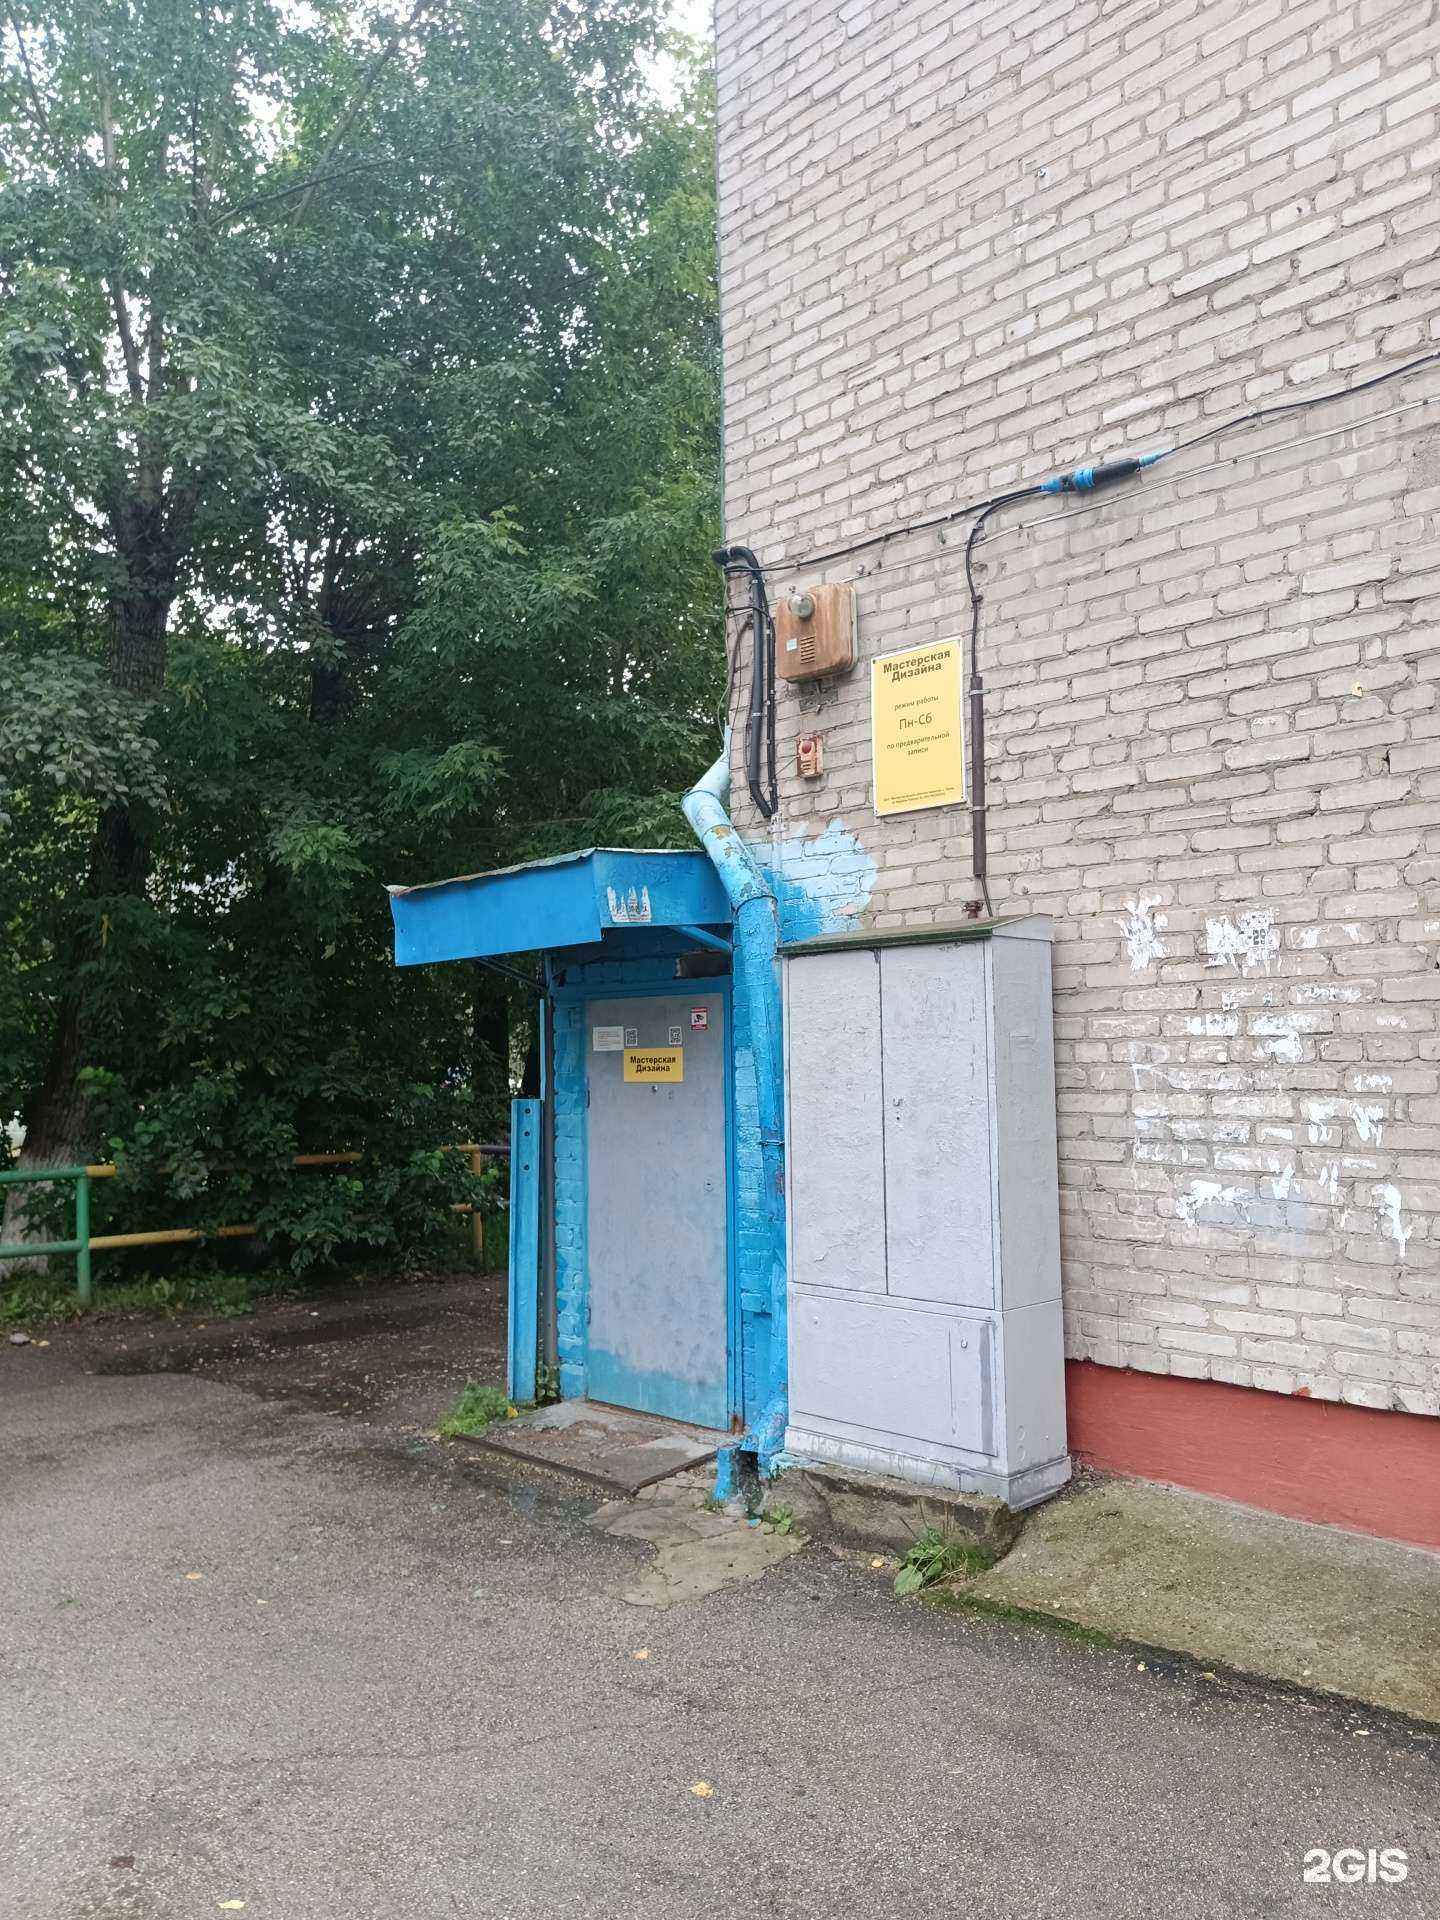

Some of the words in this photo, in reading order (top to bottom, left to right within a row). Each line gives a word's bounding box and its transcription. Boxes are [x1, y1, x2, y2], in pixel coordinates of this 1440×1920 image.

[883, 650, 951, 674] Мастерская
[891, 662, 943, 683] Дизайна
[894, 701, 915, 711] режим
[916, 696, 939, 706] работы
[899, 711, 933, 730] Пн-Сб
[895, 730, 950, 749] предварительной
[630, 1055, 676, 1065] Мастерская
[635, 1064, 671, 1073] Дизайна
